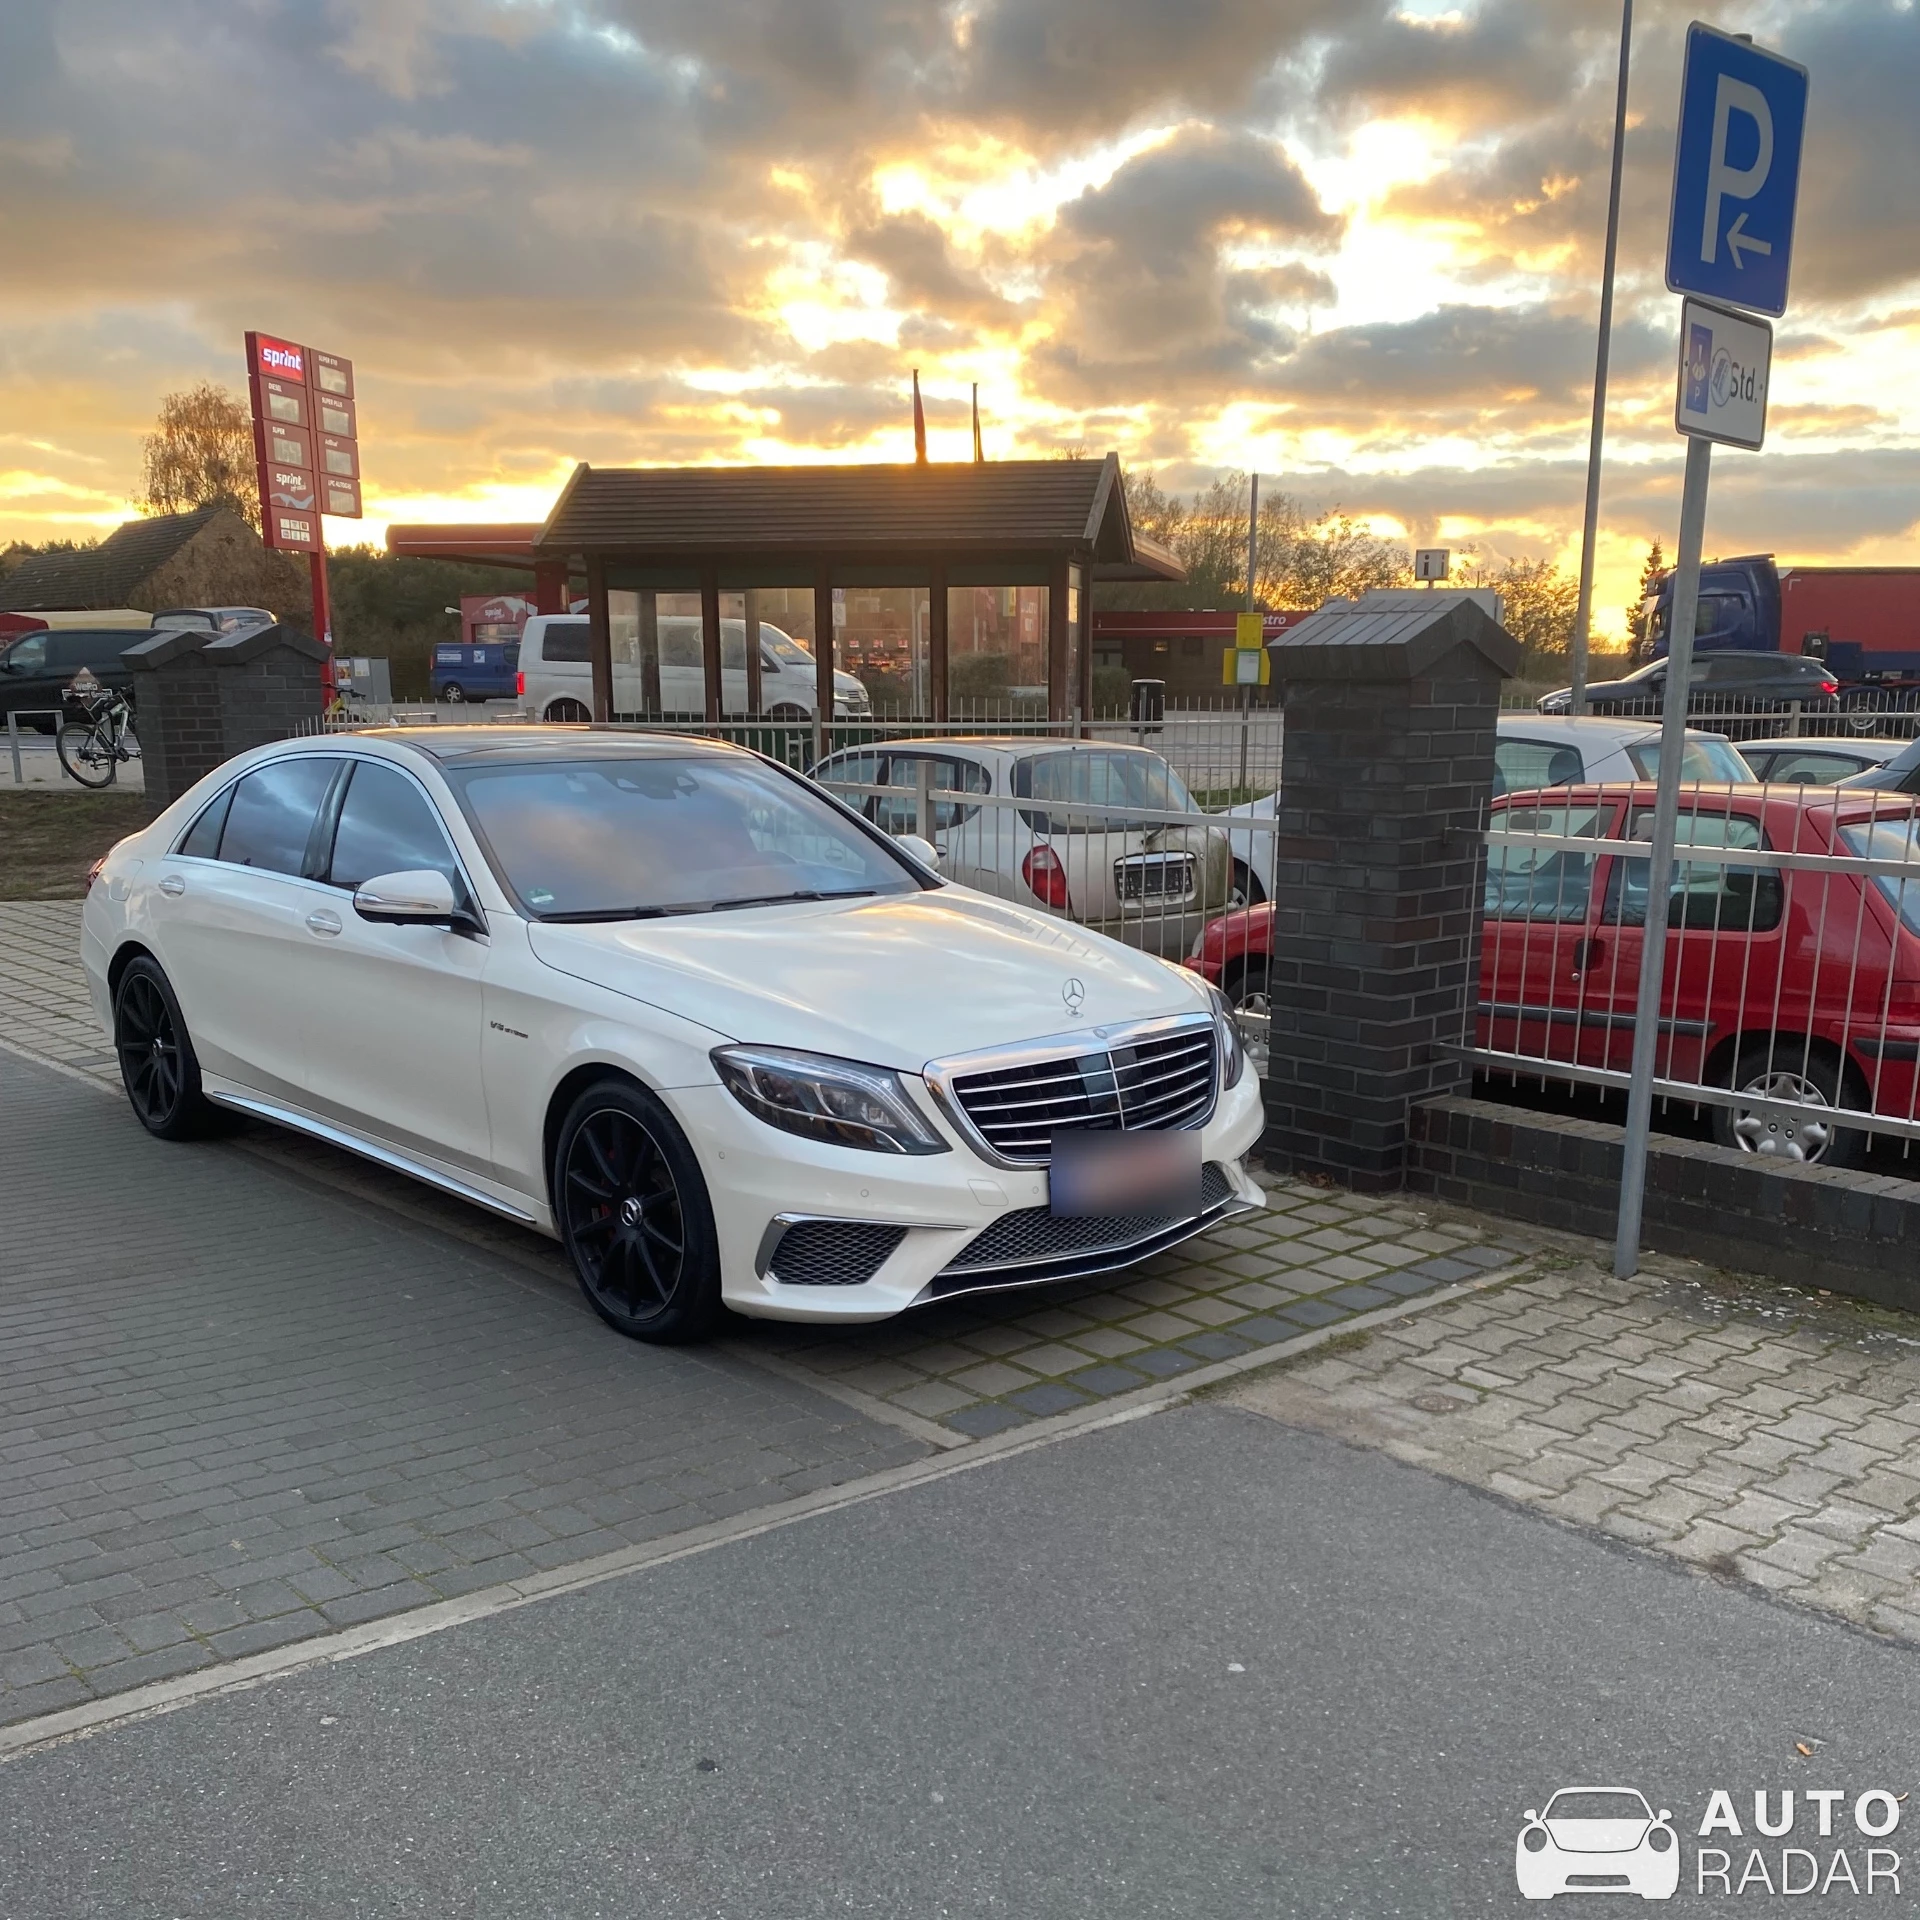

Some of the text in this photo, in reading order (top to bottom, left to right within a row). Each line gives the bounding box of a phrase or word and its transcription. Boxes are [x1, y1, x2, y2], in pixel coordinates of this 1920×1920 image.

[1701, 73, 1774, 264] P
[263, 348, 302, 371] sprint
[276, 473, 302, 485] sprint
[1262, 615, 1287, 625] stro
